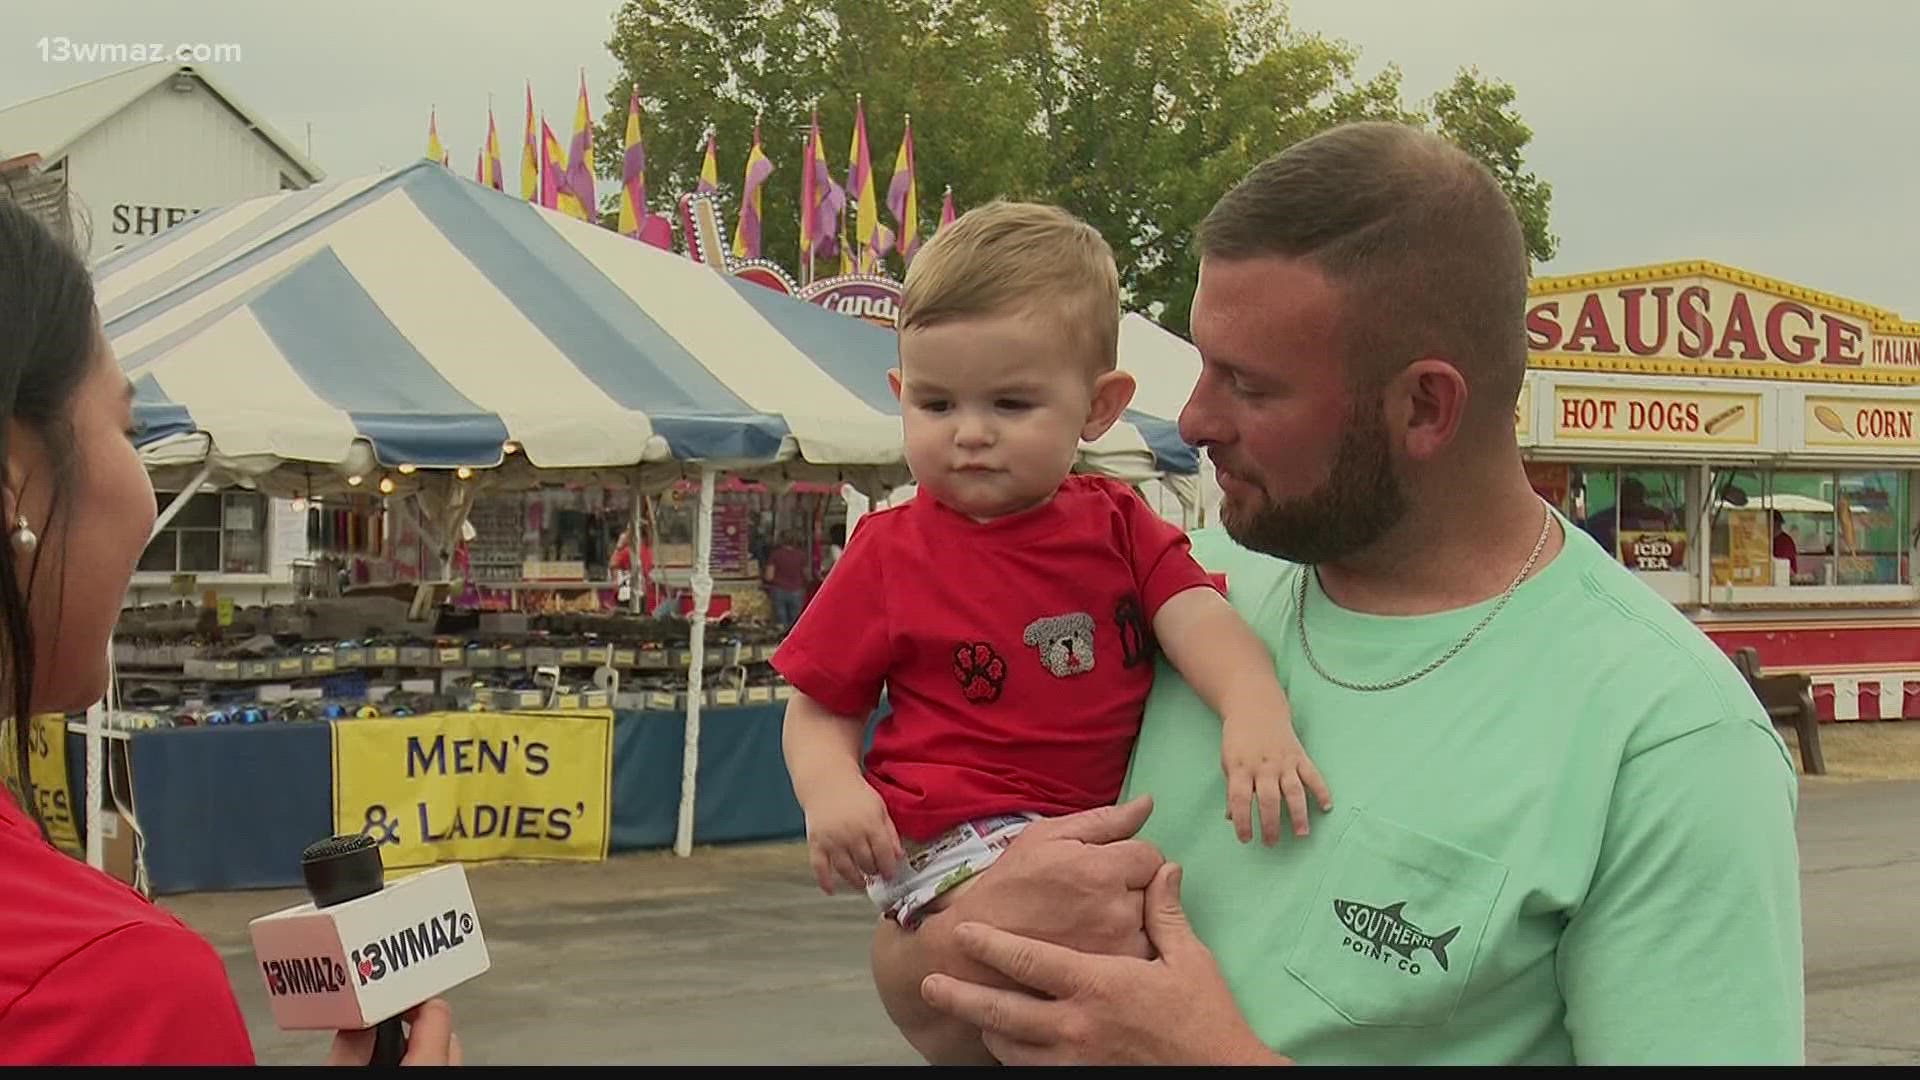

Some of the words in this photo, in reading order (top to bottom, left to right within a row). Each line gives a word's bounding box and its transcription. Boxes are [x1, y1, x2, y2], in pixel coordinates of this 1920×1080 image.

[112, 204, 201, 236] SHE
[1527, 286, 1865, 366] SAUSAGE
[1562, 398, 1617, 430] HOT
[1628, 401, 1700, 433] DOGS
[1856, 409, 1913, 438] CORN
[1633, 542, 1673, 558] ICED
[1637, 557, 1669, 571] TEA
[406, 734, 550, 778] MEN'S
[1342, 904, 1434, 949] SOUTHERN
[1341, 935, 1393, 965] POINT
[1398, 958, 1421, 976] CO
